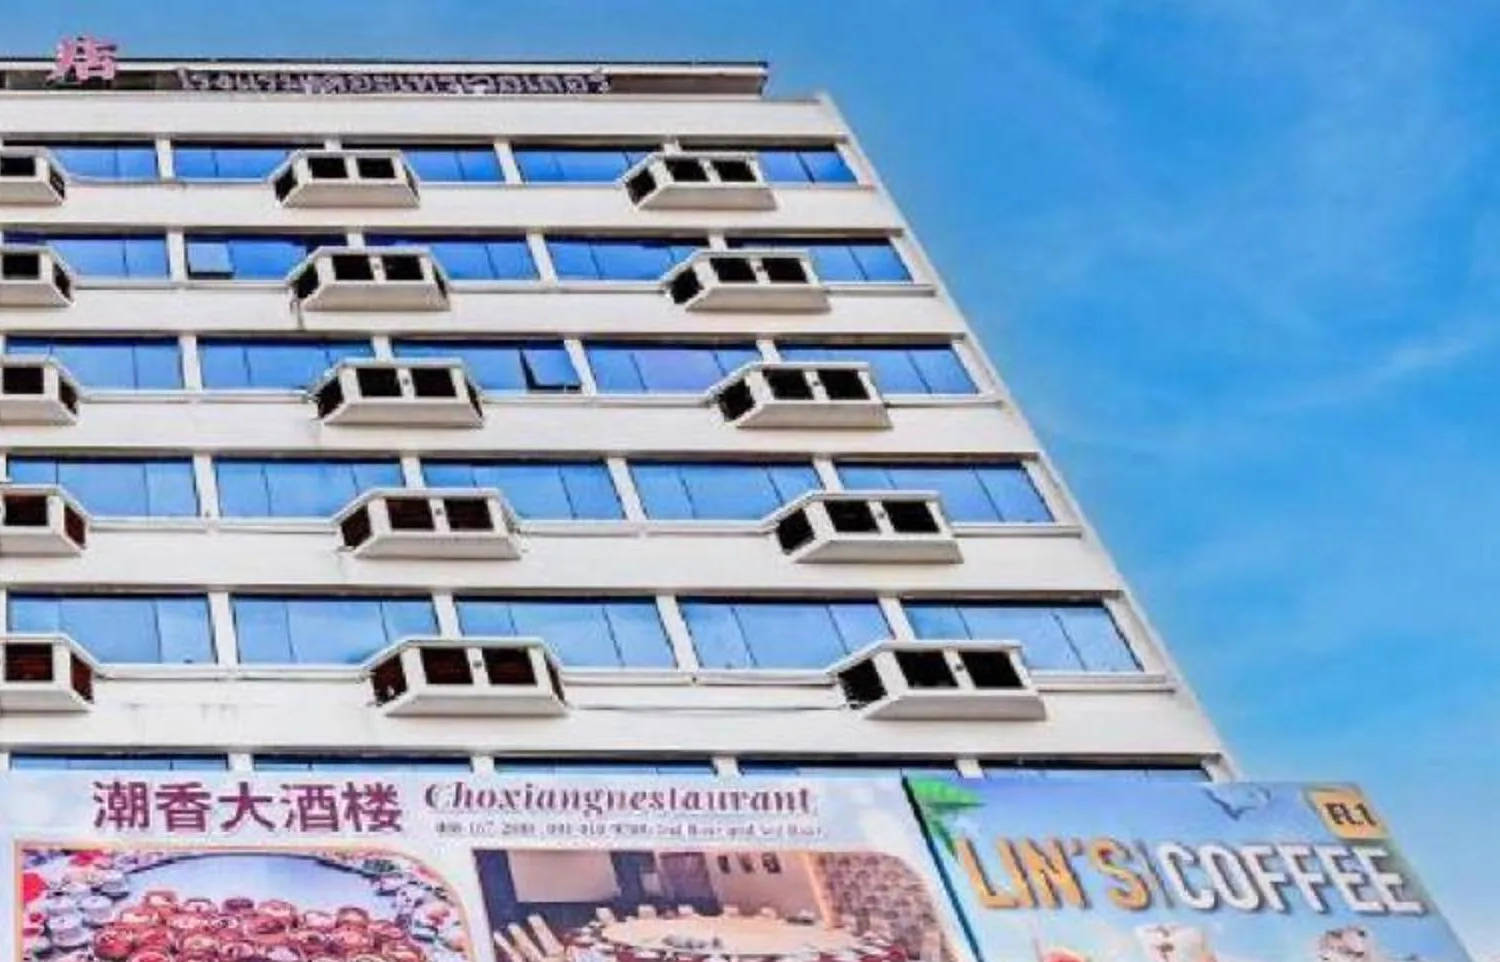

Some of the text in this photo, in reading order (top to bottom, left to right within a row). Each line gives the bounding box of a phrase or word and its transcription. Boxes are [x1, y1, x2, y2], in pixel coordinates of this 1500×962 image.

[92, 781, 403, 833] 潮香大酒楼
[1156, 841, 1425, 915] COFFEE
